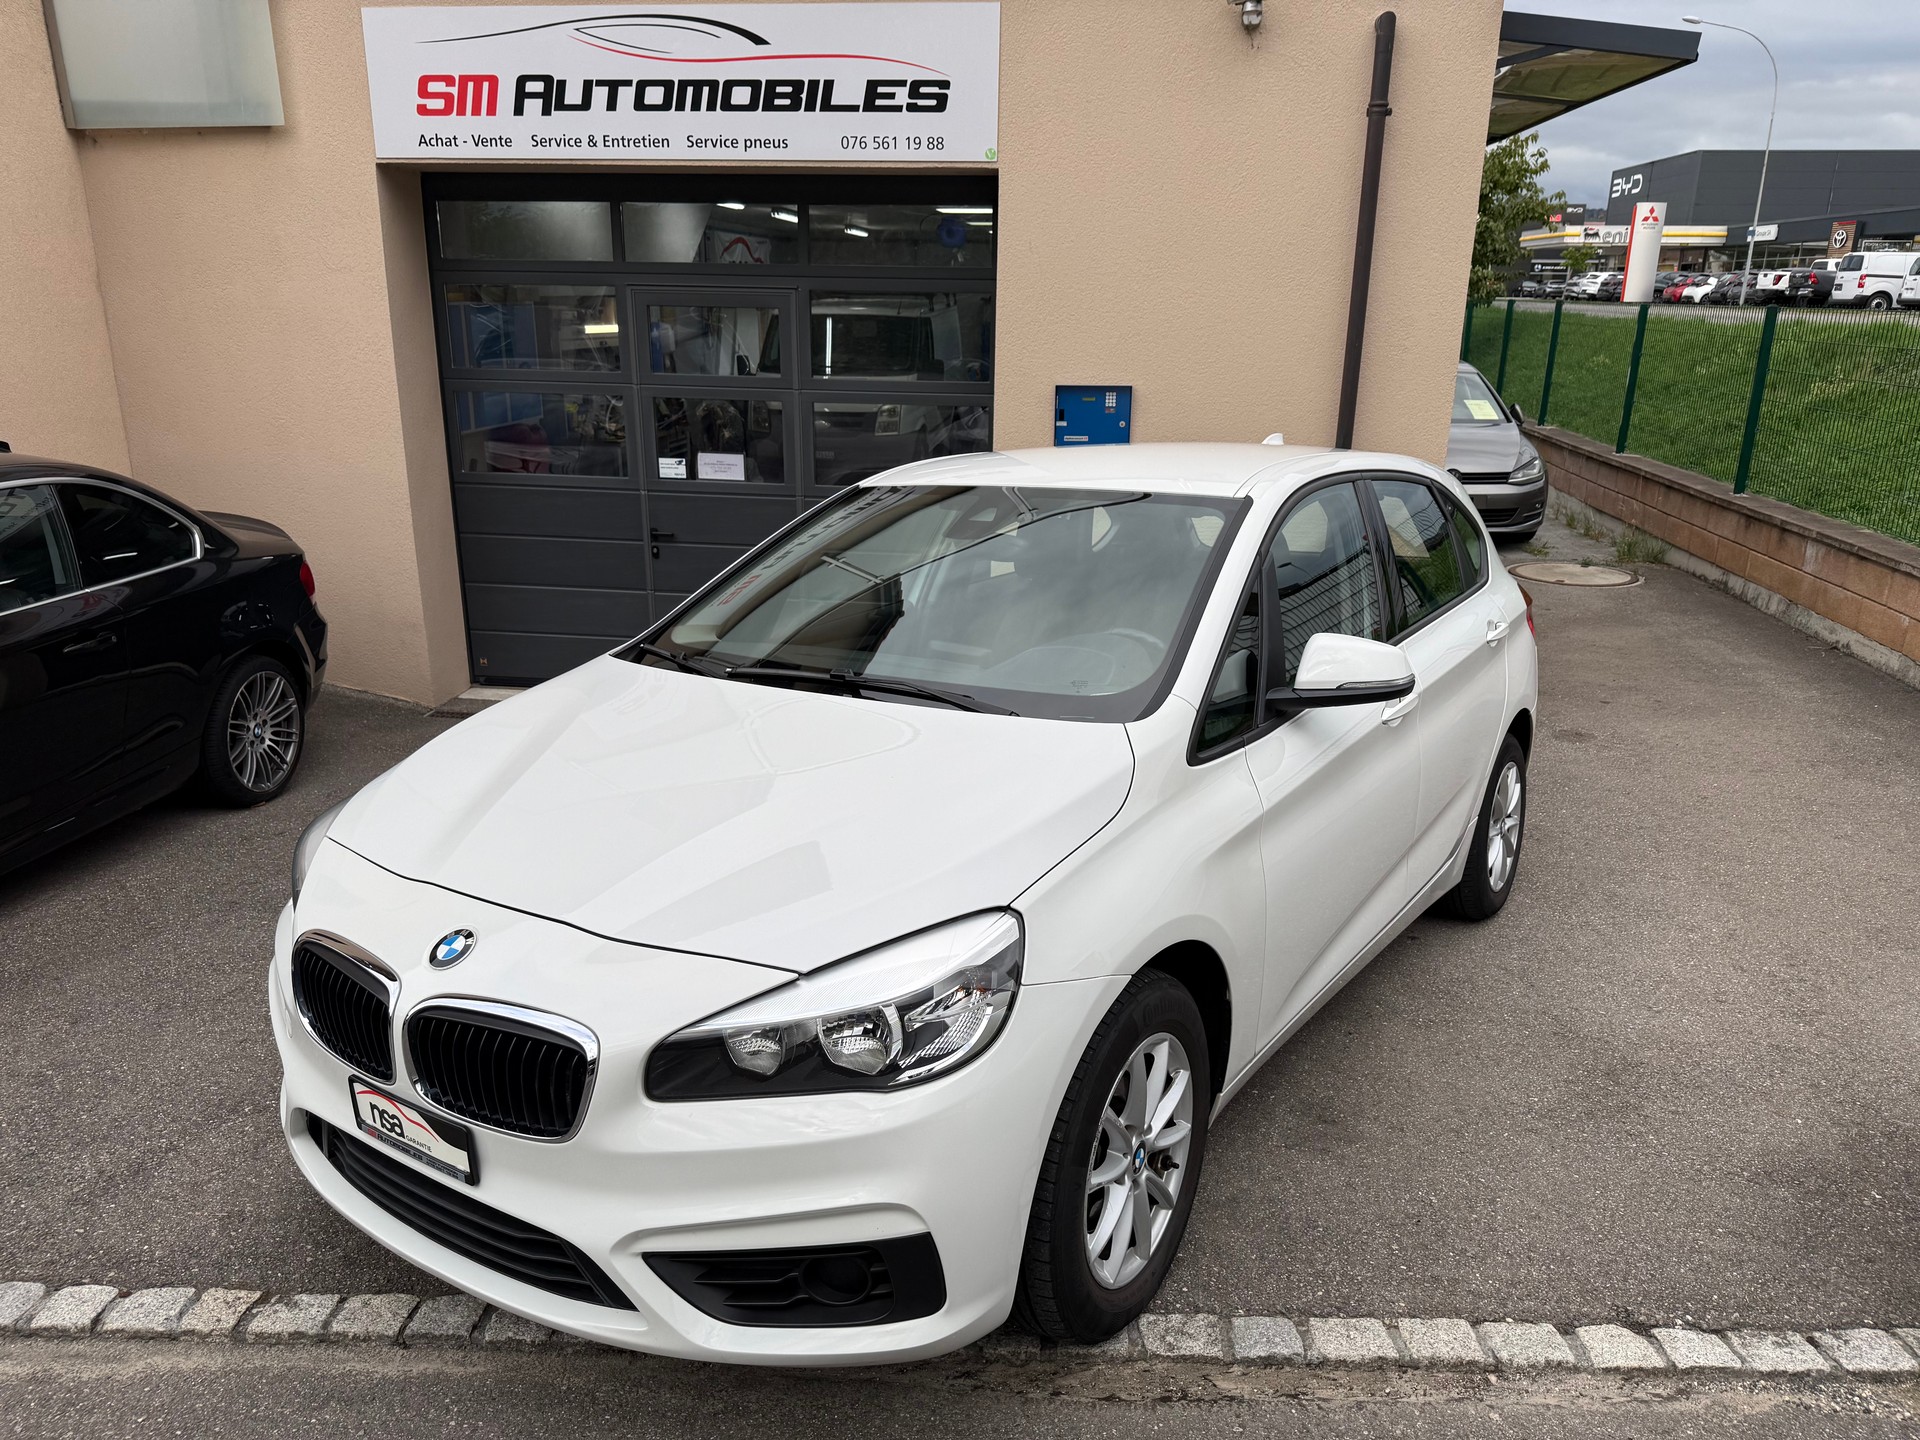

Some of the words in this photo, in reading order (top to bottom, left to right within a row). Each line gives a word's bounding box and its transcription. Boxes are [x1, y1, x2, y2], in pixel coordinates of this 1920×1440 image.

[417, 74, 499, 117] SM
[513, 74, 951, 117] AUTOMOBILES
[418, 133, 459, 148] Achat
[471, 134, 513, 148] Vente
[530, 133, 583, 148] Service
[588, 134, 598, 148] &
[603, 133, 670, 149] Entretien
[687, 134, 739, 149] Service
[744, 138, 789, 153] pneus
[841, 135, 868, 150] 076
[874, 136, 897, 150] 561
[905, 136, 922, 151] 19
[926, 136, 945, 151] 88
[1611, 173, 1643, 198] BYD
[1602, 227, 1629, 243] eni
[369, 1101, 406, 1140] nsa
[405, 1134, 433, 1153] GARANTIE
